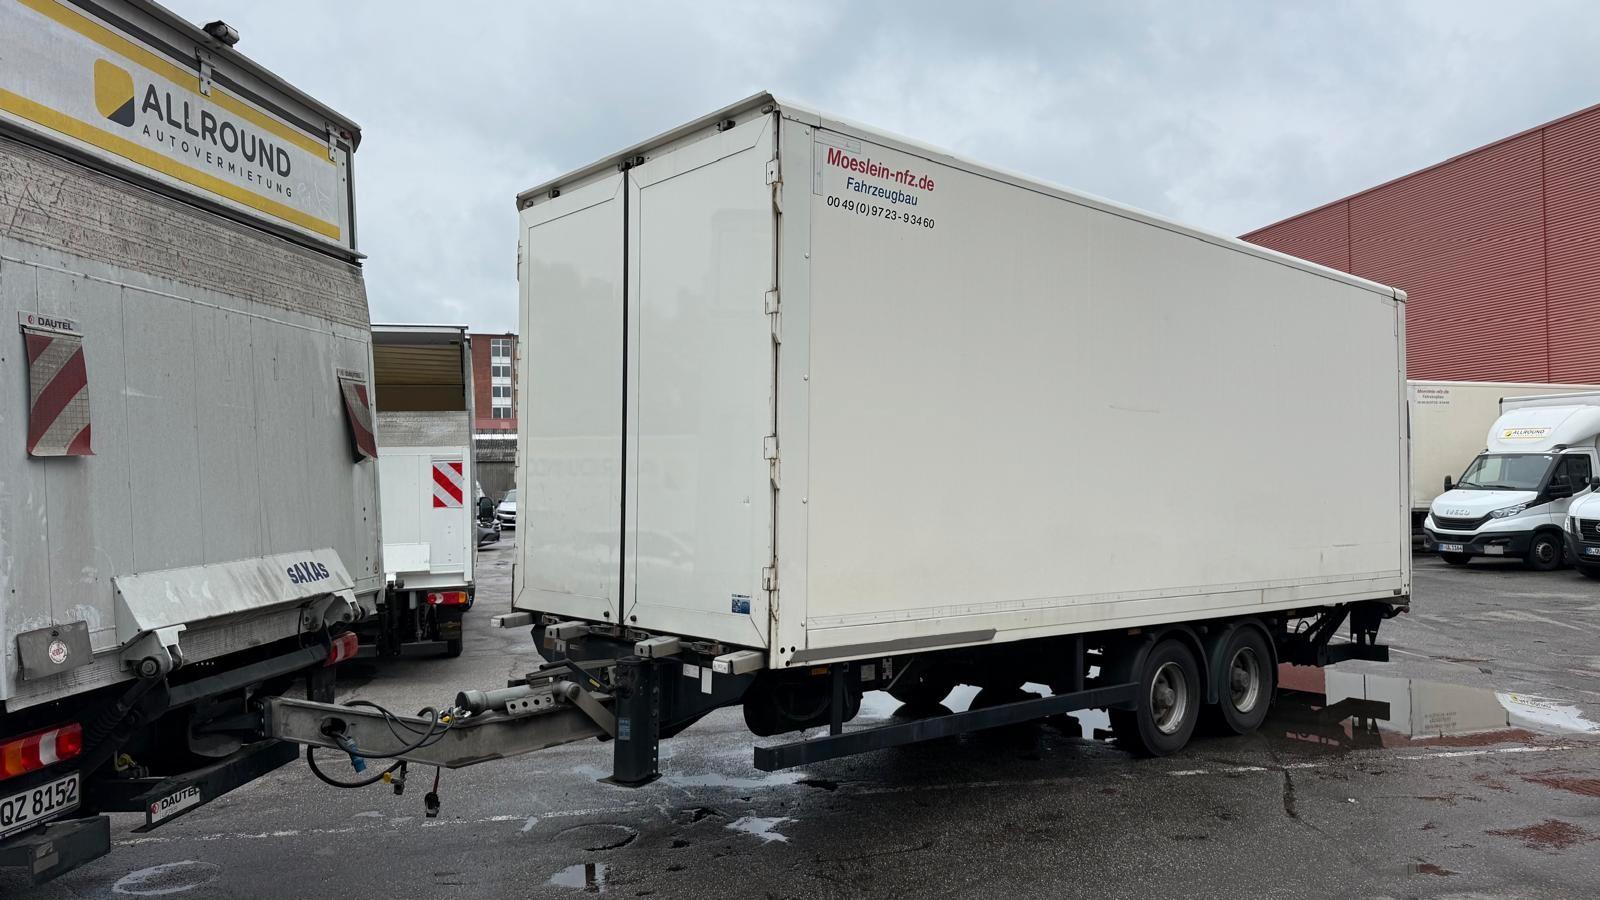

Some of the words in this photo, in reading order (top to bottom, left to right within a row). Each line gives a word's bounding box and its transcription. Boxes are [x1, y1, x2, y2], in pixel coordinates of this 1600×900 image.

[141, 83, 291, 178] ALLROUND
[142, 124, 292, 198] AUTOVERMIETUNG
[827, 147, 935, 192] Moeslein-nfz.de
[846, 176, 918, 206] Fahrzeugbau
[37, 316, 73, 331] DAUTEL
[286, 561, 330, 584] SAXAS
[0, 795, 28, 826] QZ
[32, 778, 77, 816] 8152
[161, 787, 200, 810] DAUTEL
